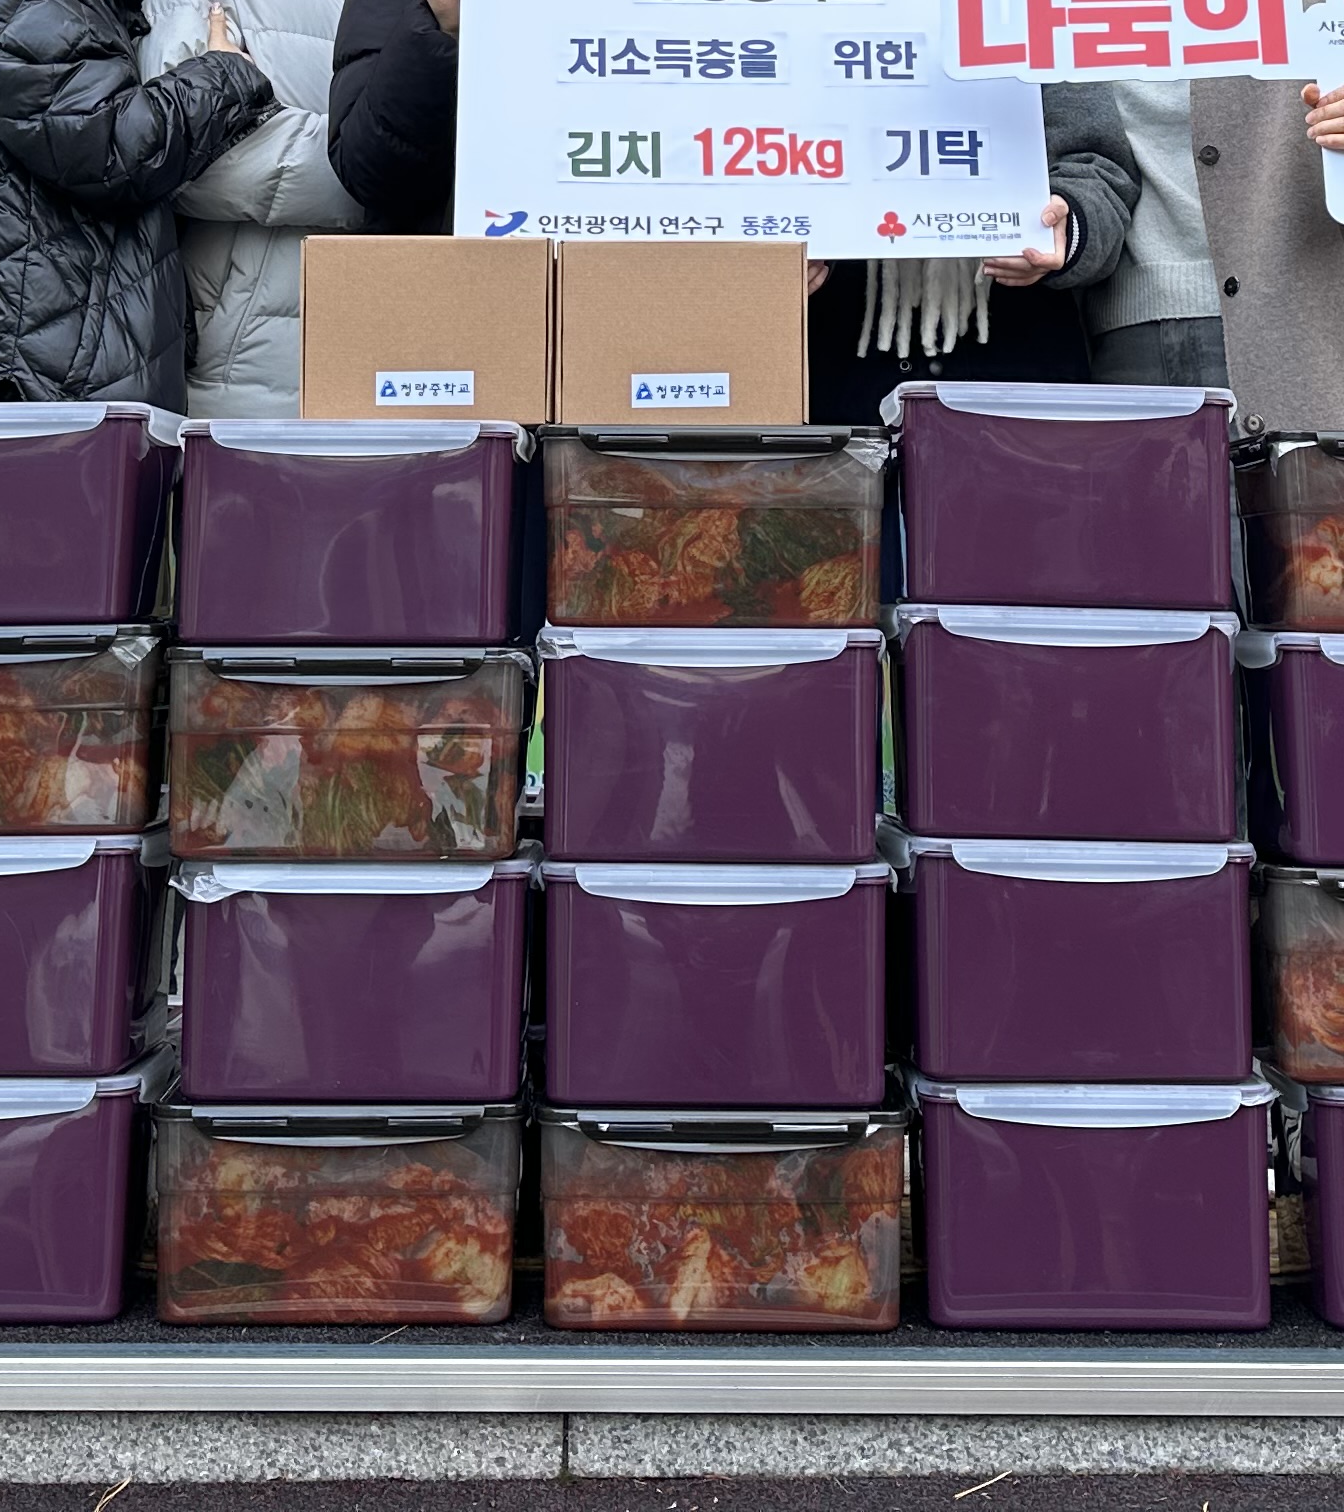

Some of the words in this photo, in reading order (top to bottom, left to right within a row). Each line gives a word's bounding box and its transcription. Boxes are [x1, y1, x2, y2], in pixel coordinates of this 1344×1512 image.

[568, 37, 778, 79] 저소득층을
[832, 40, 917, 80] 위한
[566, 129, 662, 178] 김치
[693, 126, 844, 179] 125kg
[884, 129, 983, 177] 기탁
[537, 215, 652, 235] 인천광역시
[659, 215, 725, 235] 연수구
[740, 215, 812, 237] 동춘2동
[911, 212, 1021, 233] 사랑의열매
[399, 381, 471, 396] 청량중학교
[655, 383, 727, 398] 청량중학교
